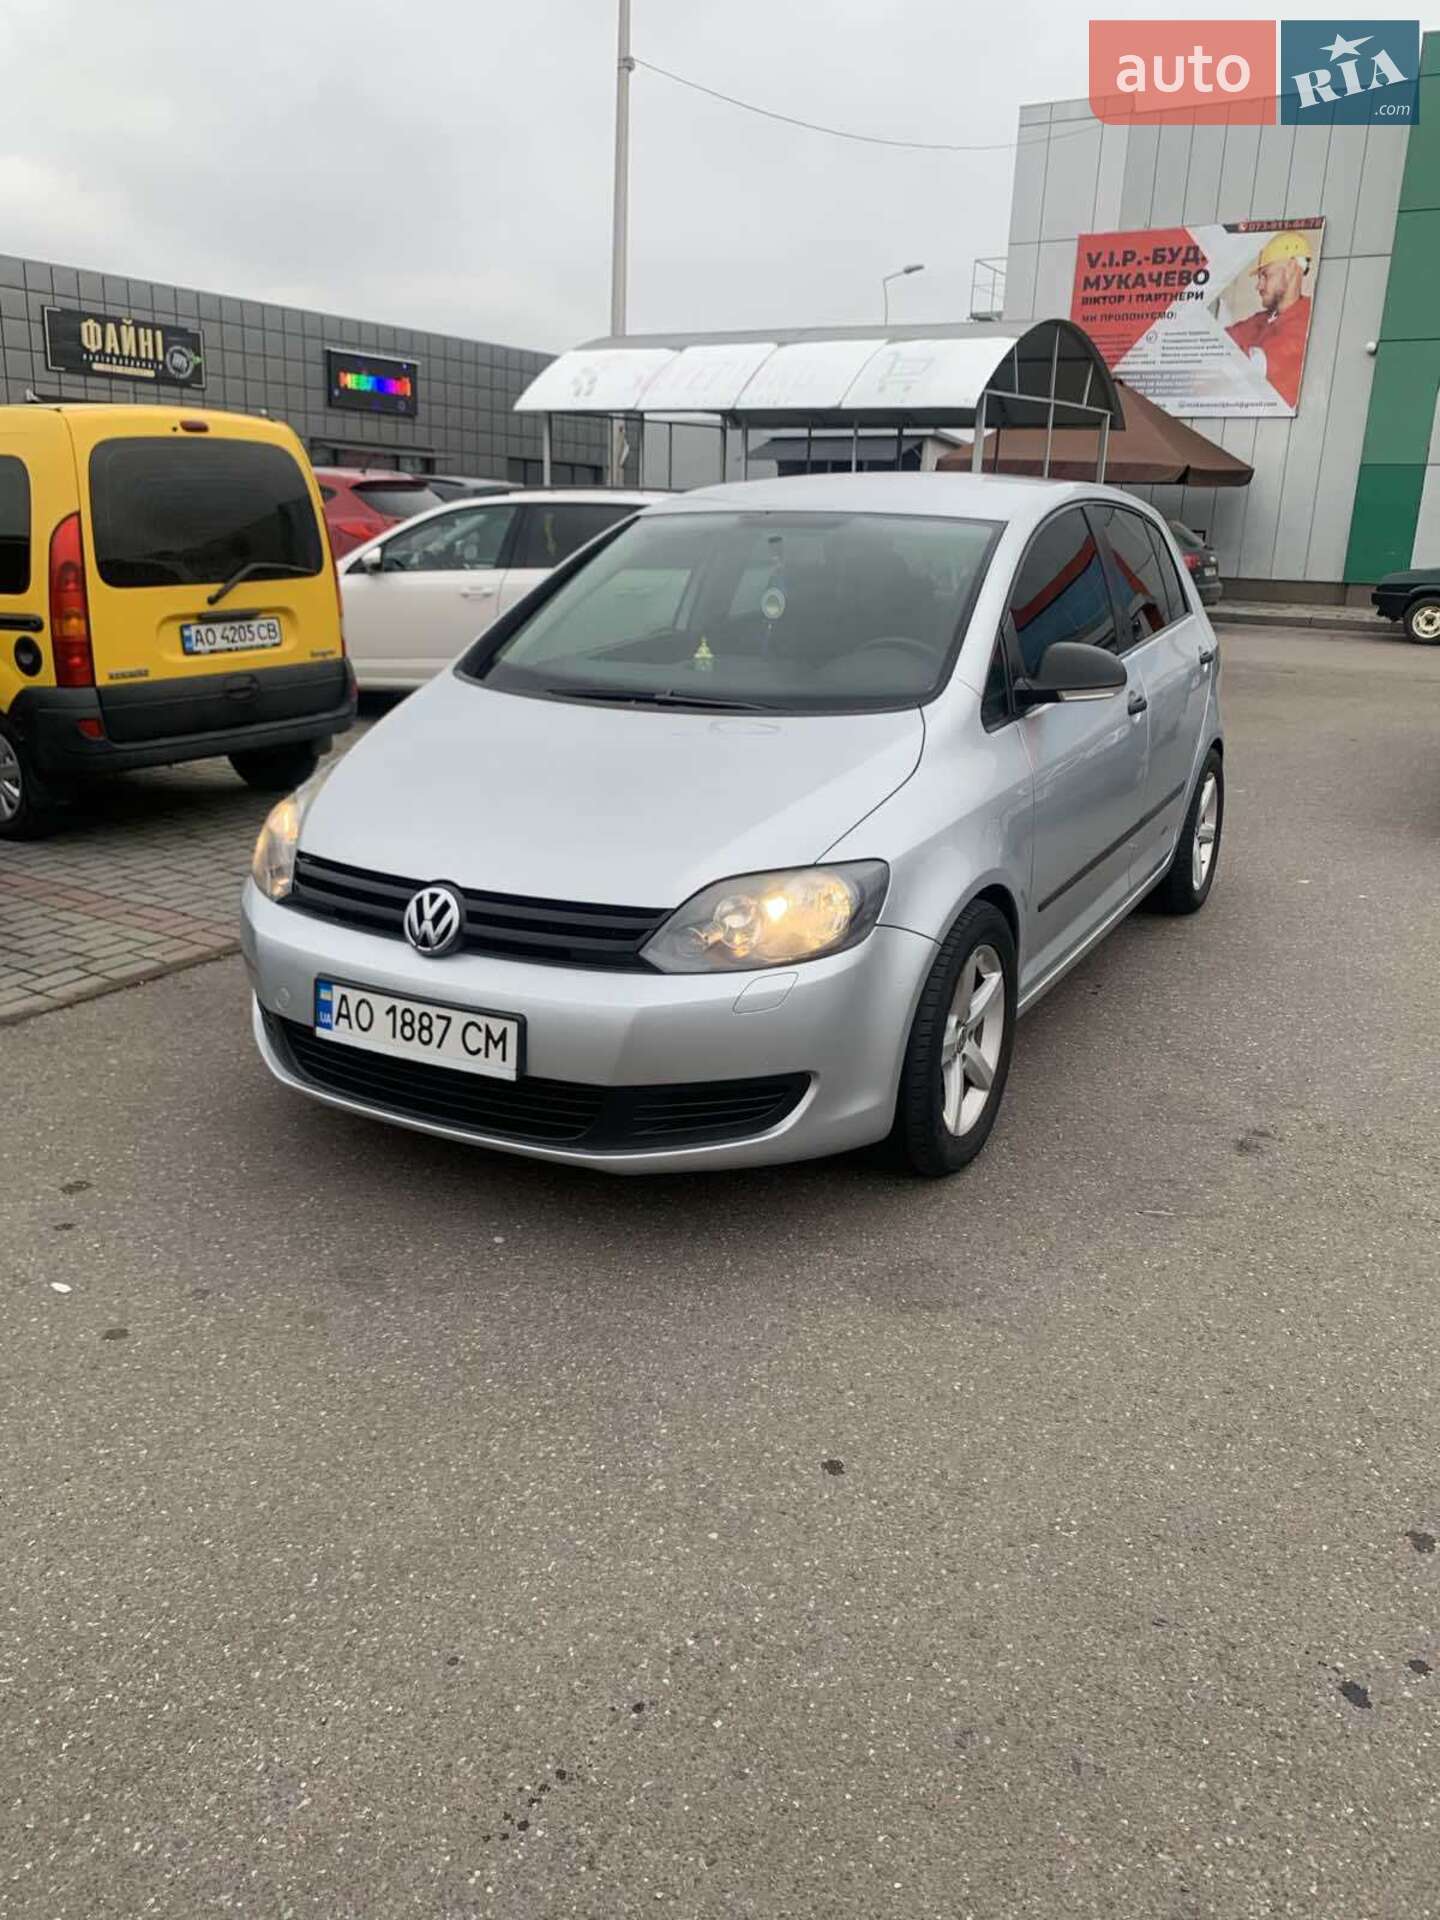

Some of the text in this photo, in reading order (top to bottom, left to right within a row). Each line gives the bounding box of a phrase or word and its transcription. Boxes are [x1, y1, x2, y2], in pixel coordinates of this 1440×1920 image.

[1082, 268, 1210, 291] МУКАЧЕВО
[1137, 291, 1204, 303] ПАРТНЕРИ
[80, 317, 164, 361] ФАЙНІ
[195, 623, 278, 646] AO 4205 CB
[319, 1010, 332, 1025] UA
[335, 994, 508, 1062] AO 1887 CM
